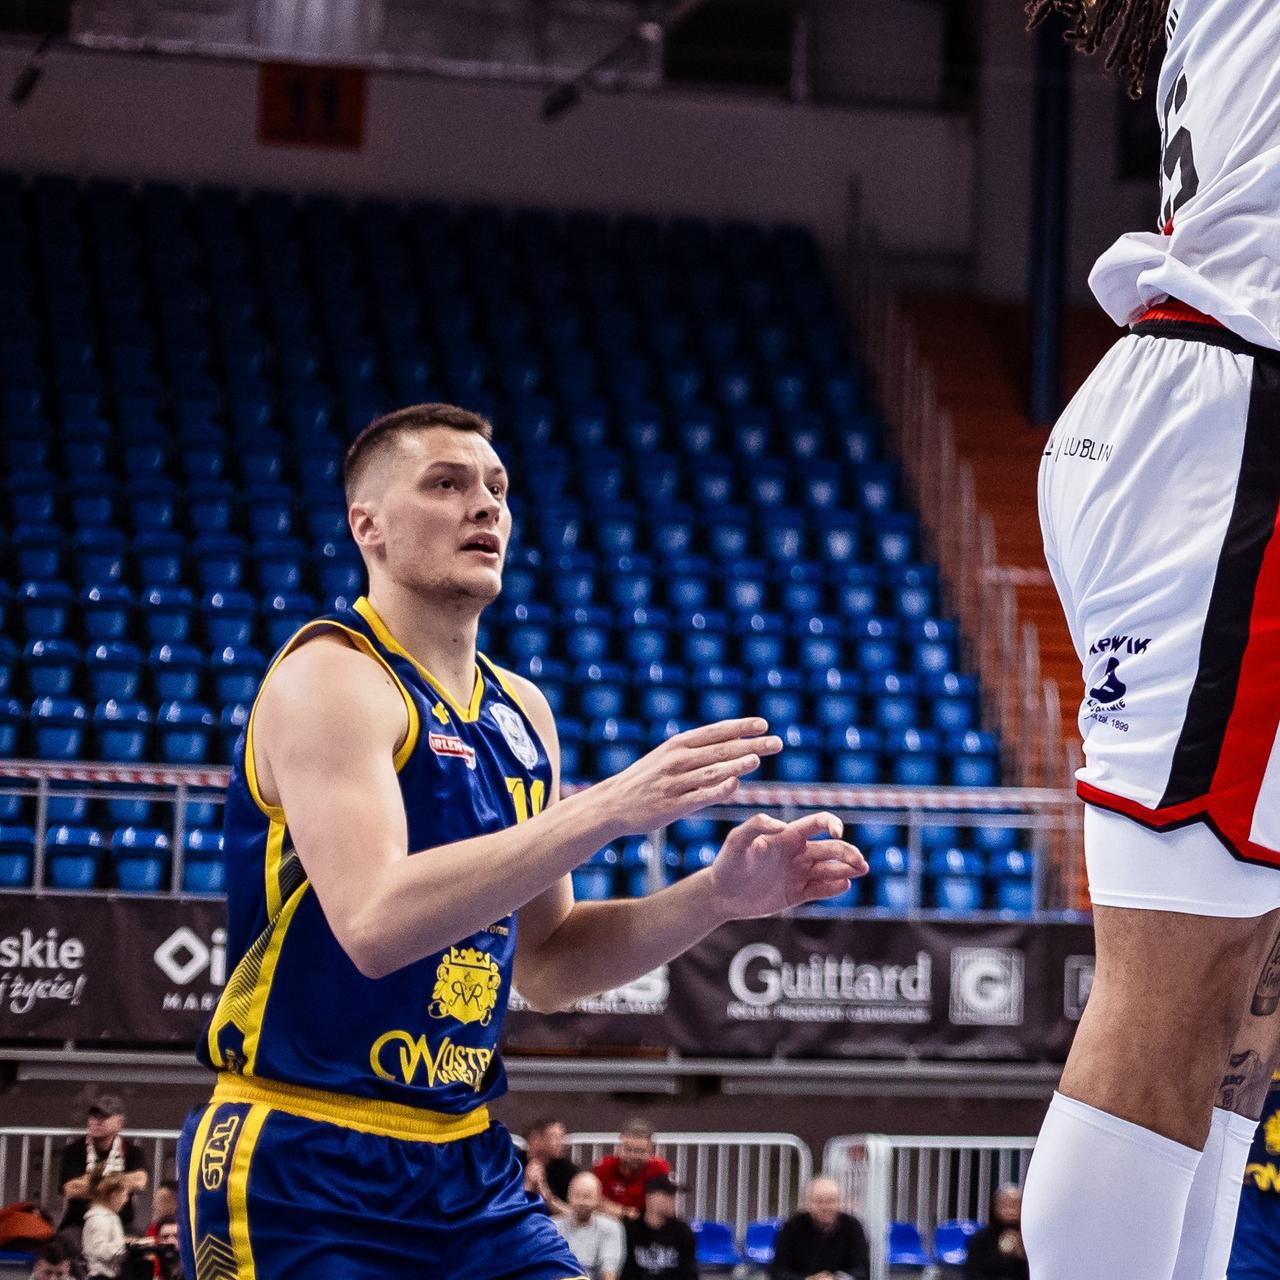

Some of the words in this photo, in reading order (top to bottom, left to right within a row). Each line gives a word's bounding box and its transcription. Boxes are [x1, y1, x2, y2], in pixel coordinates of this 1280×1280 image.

[1063, 436, 1114, 462] LUBLIN
[1111, 719, 1130, 733] 1899
[728, 942, 933, 1007] Guittard
[202, 1115, 240, 1190] STAL
